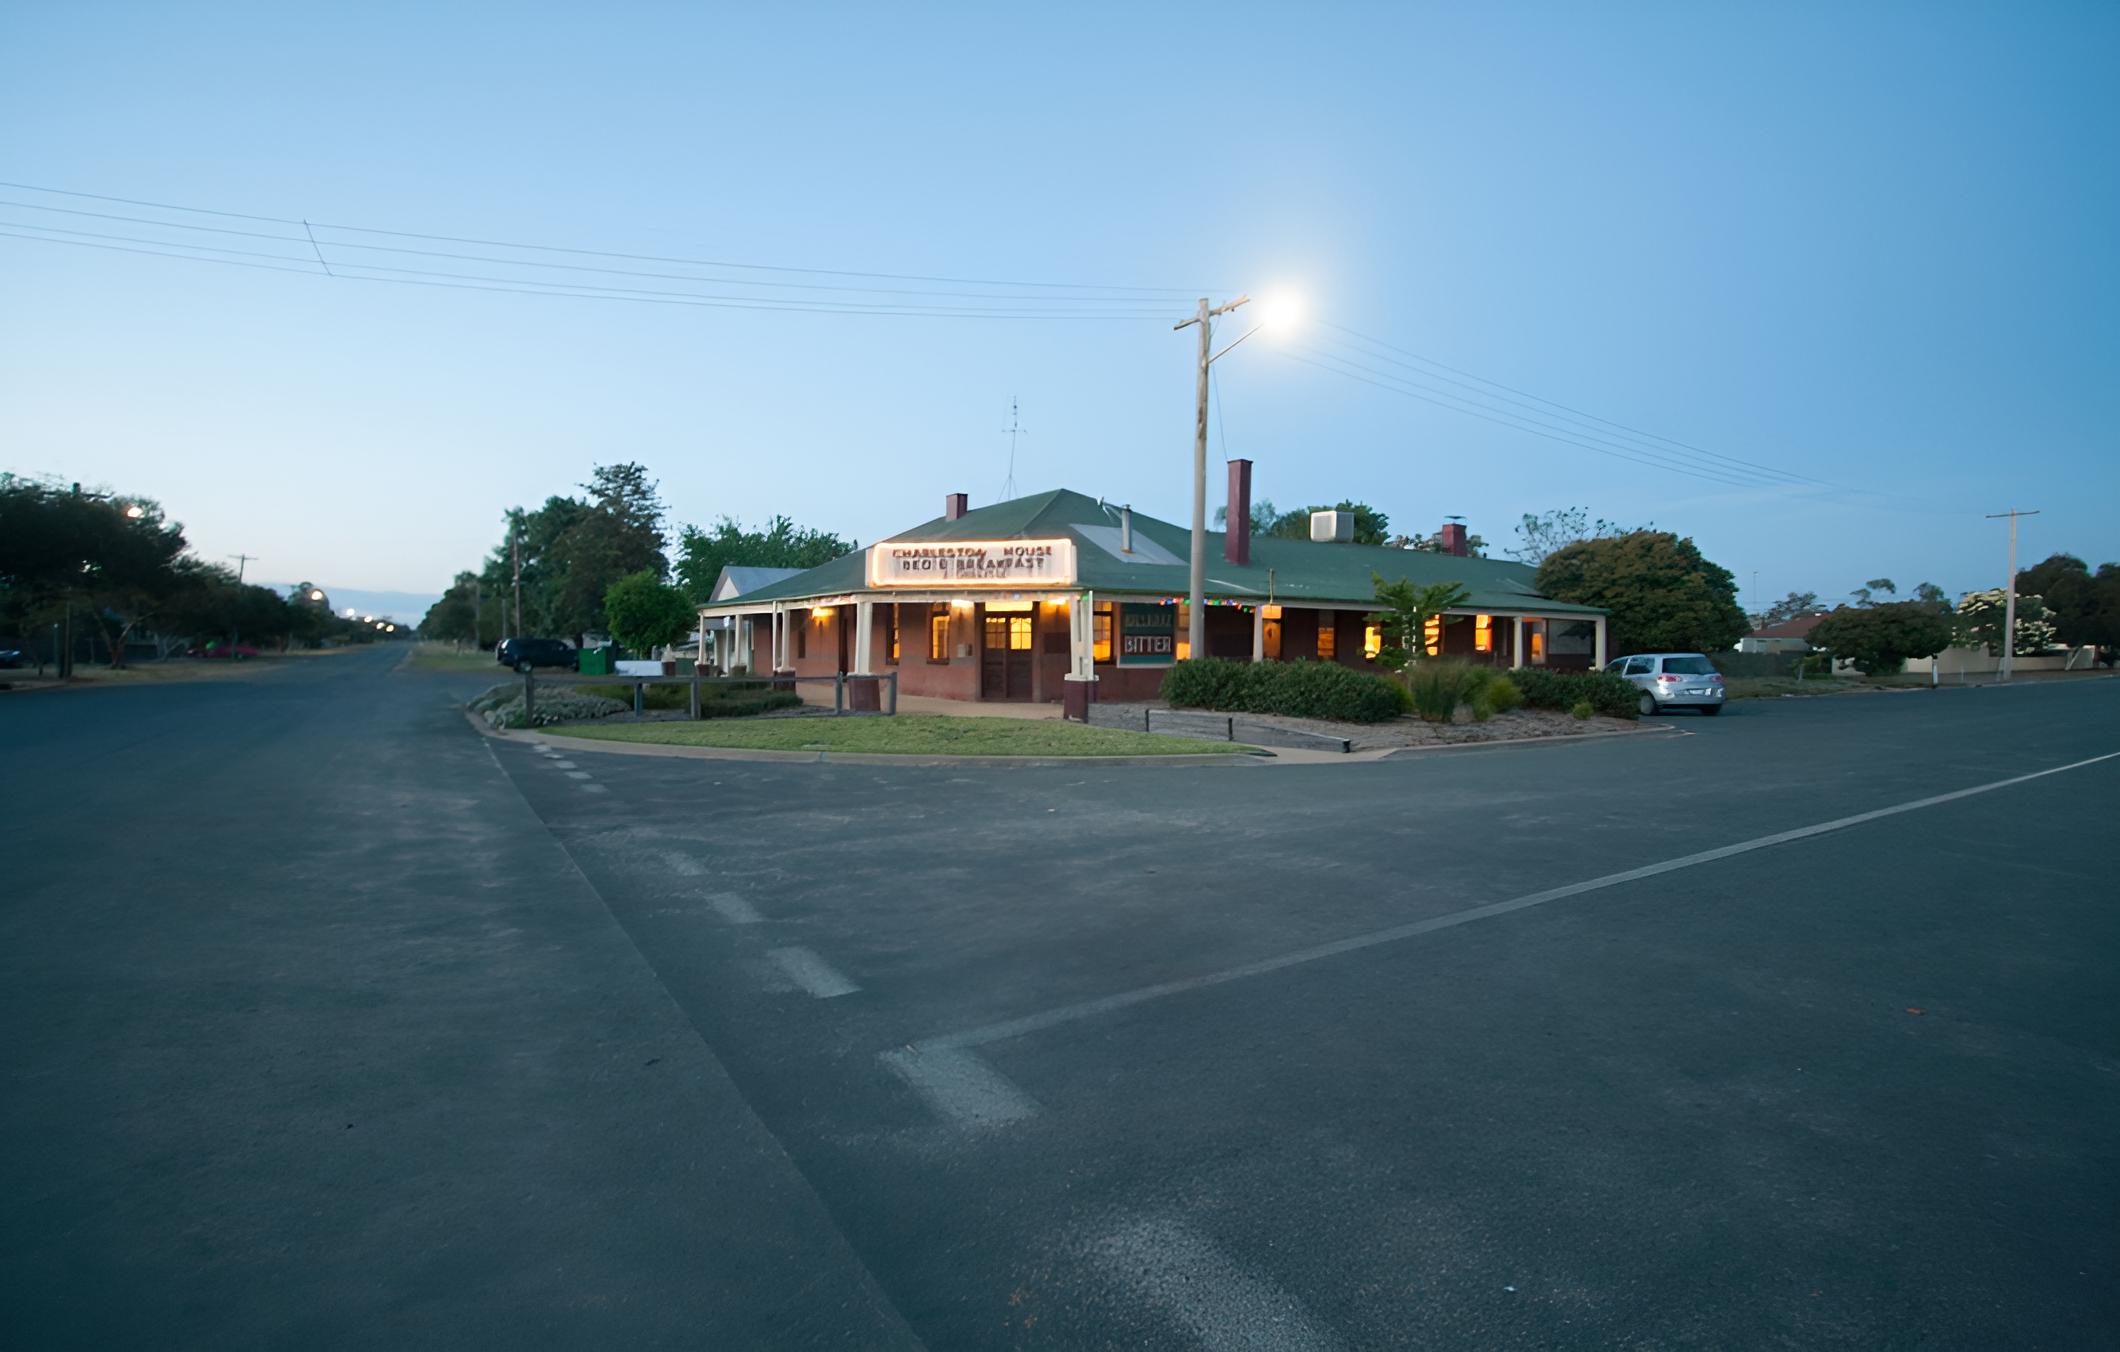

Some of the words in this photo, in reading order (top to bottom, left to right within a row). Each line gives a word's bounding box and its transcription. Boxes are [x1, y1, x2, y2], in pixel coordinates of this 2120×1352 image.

[1003, 545, 1052, 556] HOUSE
[902, 559, 932, 571] BED
[1124, 635, 1171, 653] BITTER
